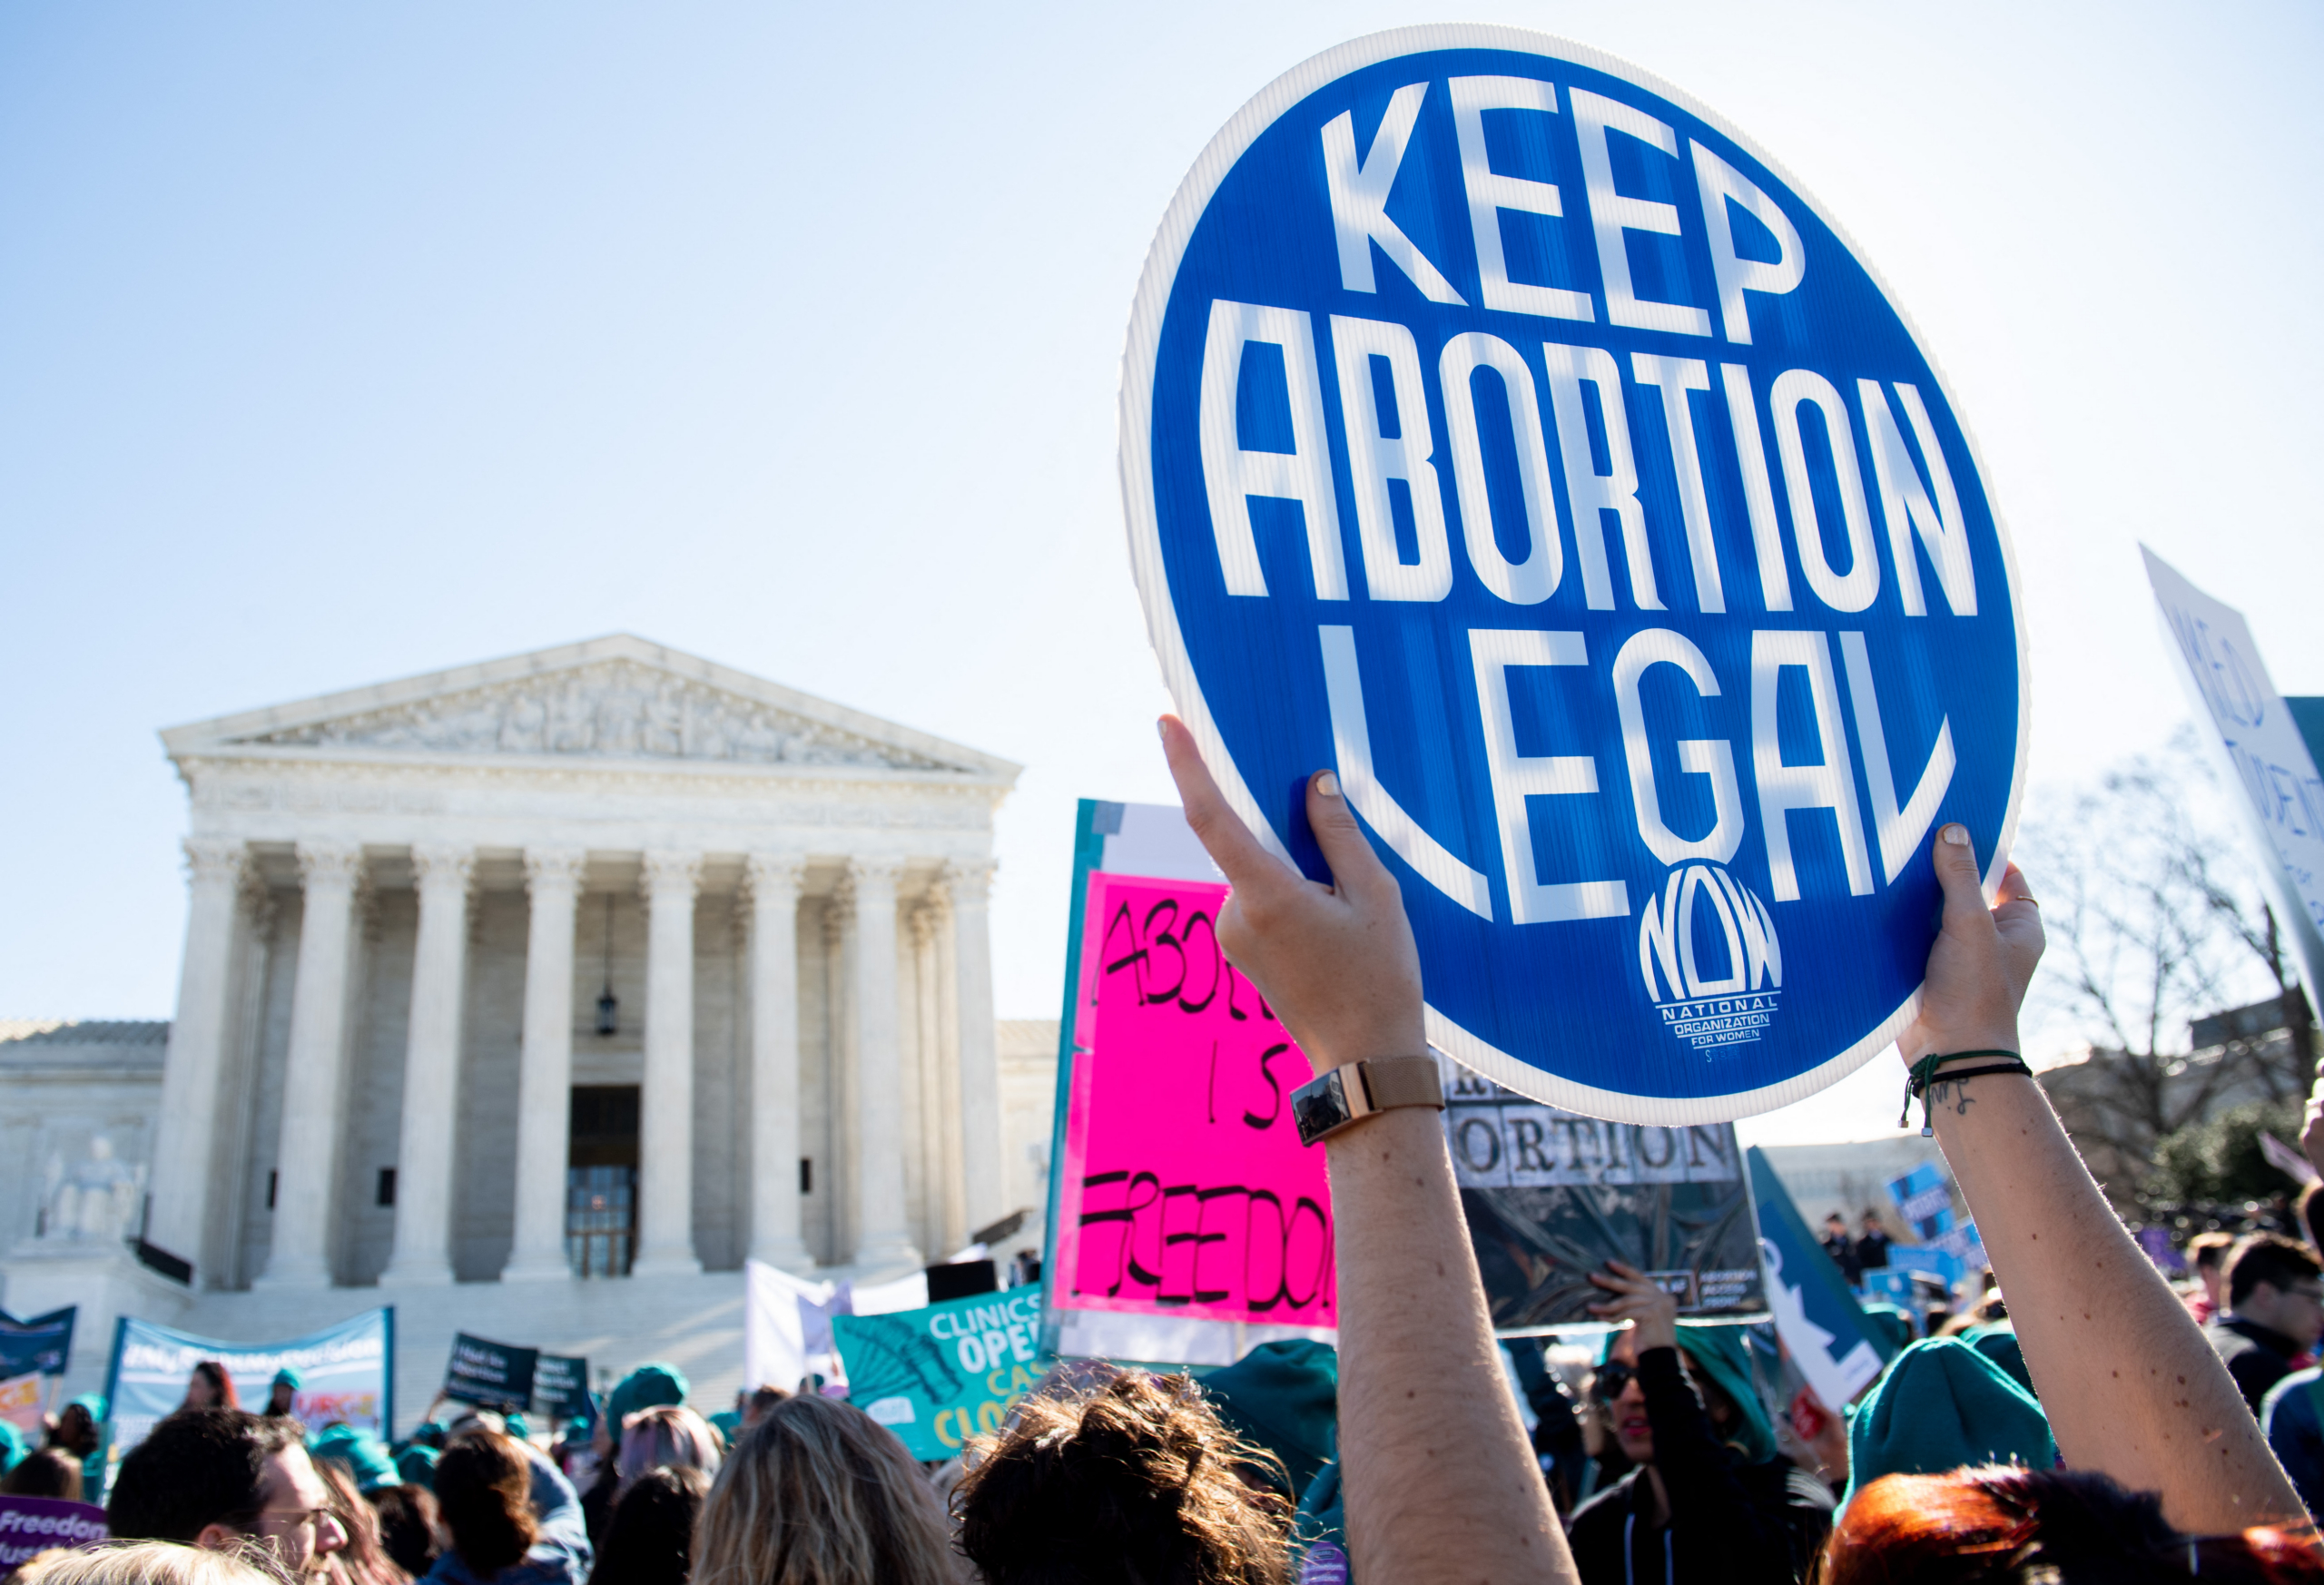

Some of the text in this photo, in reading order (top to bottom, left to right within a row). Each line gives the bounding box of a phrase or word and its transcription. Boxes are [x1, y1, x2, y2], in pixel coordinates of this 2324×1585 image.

[1321, 74, 1806, 345] KEEP
[1199, 299, 1978, 617] ABORTION
[1318, 625, 1956, 925] LEGAL
[1639, 865, 1783, 1002] NOW
[1662, 996, 1777, 1020] NATIONAL
[1675, 1013, 1769, 1035] ORGANIZATION
[1691, 1029, 1760, 1046] FOR WOMEN
[1209, 1040, 1289, 1130] IS
[1456, 1117, 1728, 1173] ORTION
[1071, 1170, 1335, 1312] FREEDO
